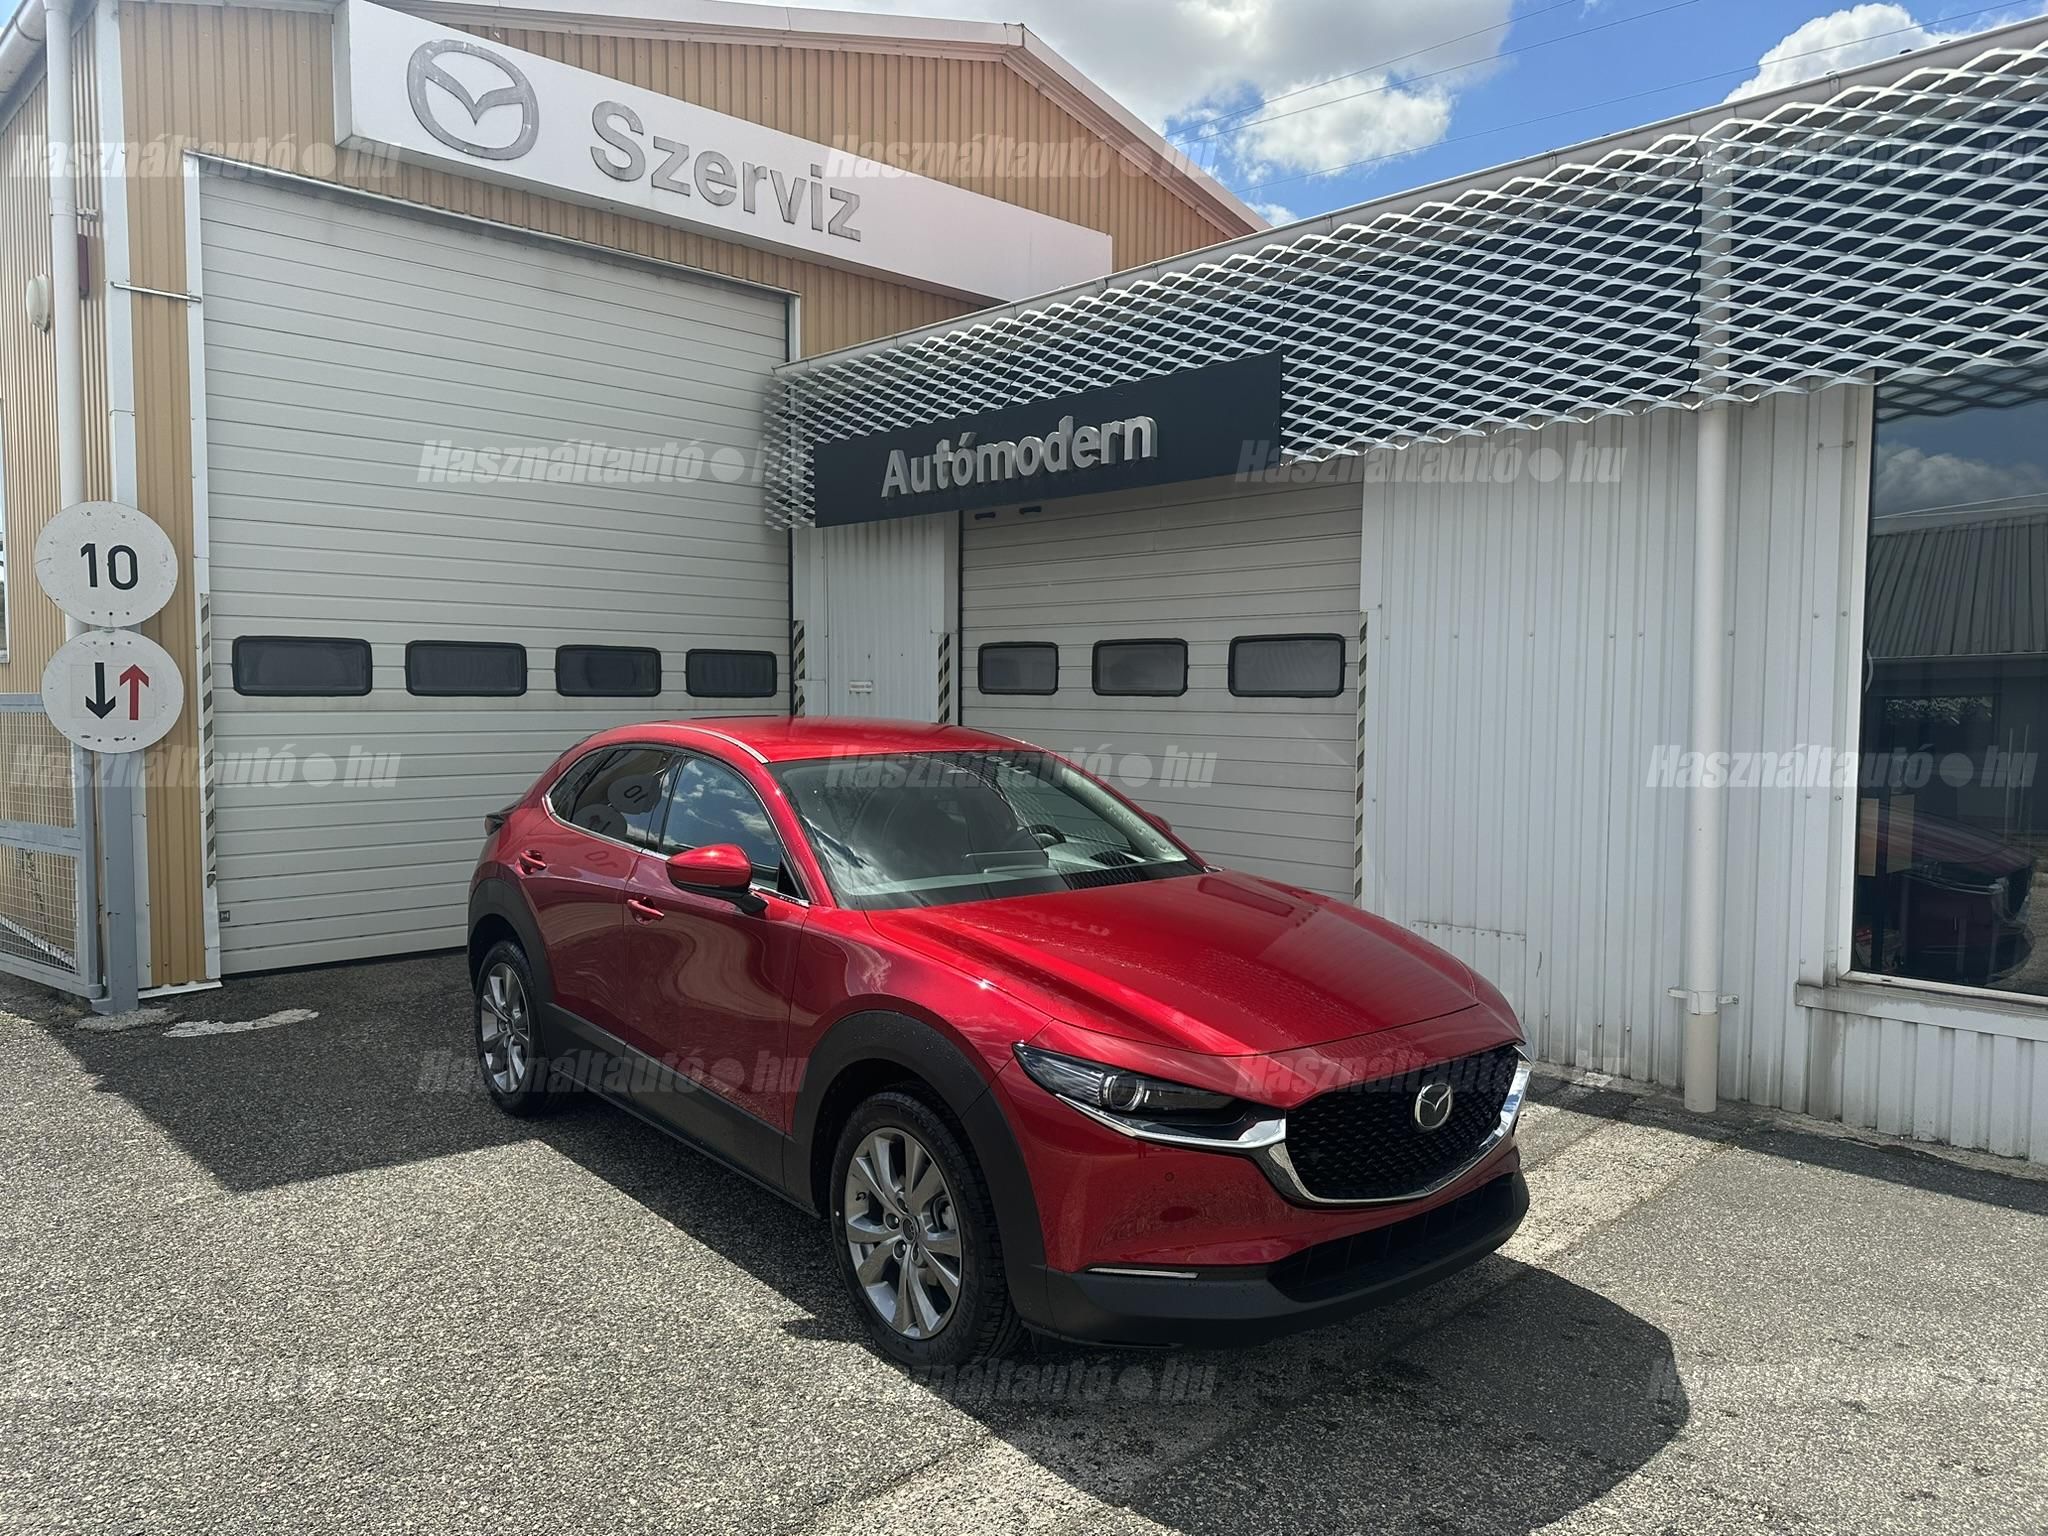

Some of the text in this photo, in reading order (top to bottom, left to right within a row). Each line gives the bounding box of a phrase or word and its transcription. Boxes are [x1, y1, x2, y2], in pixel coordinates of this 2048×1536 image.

[589, 99, 861, 242] Szerviz
[881, 412, 1158, 498] Autómodern
[80, 543, 139, 590] 10
